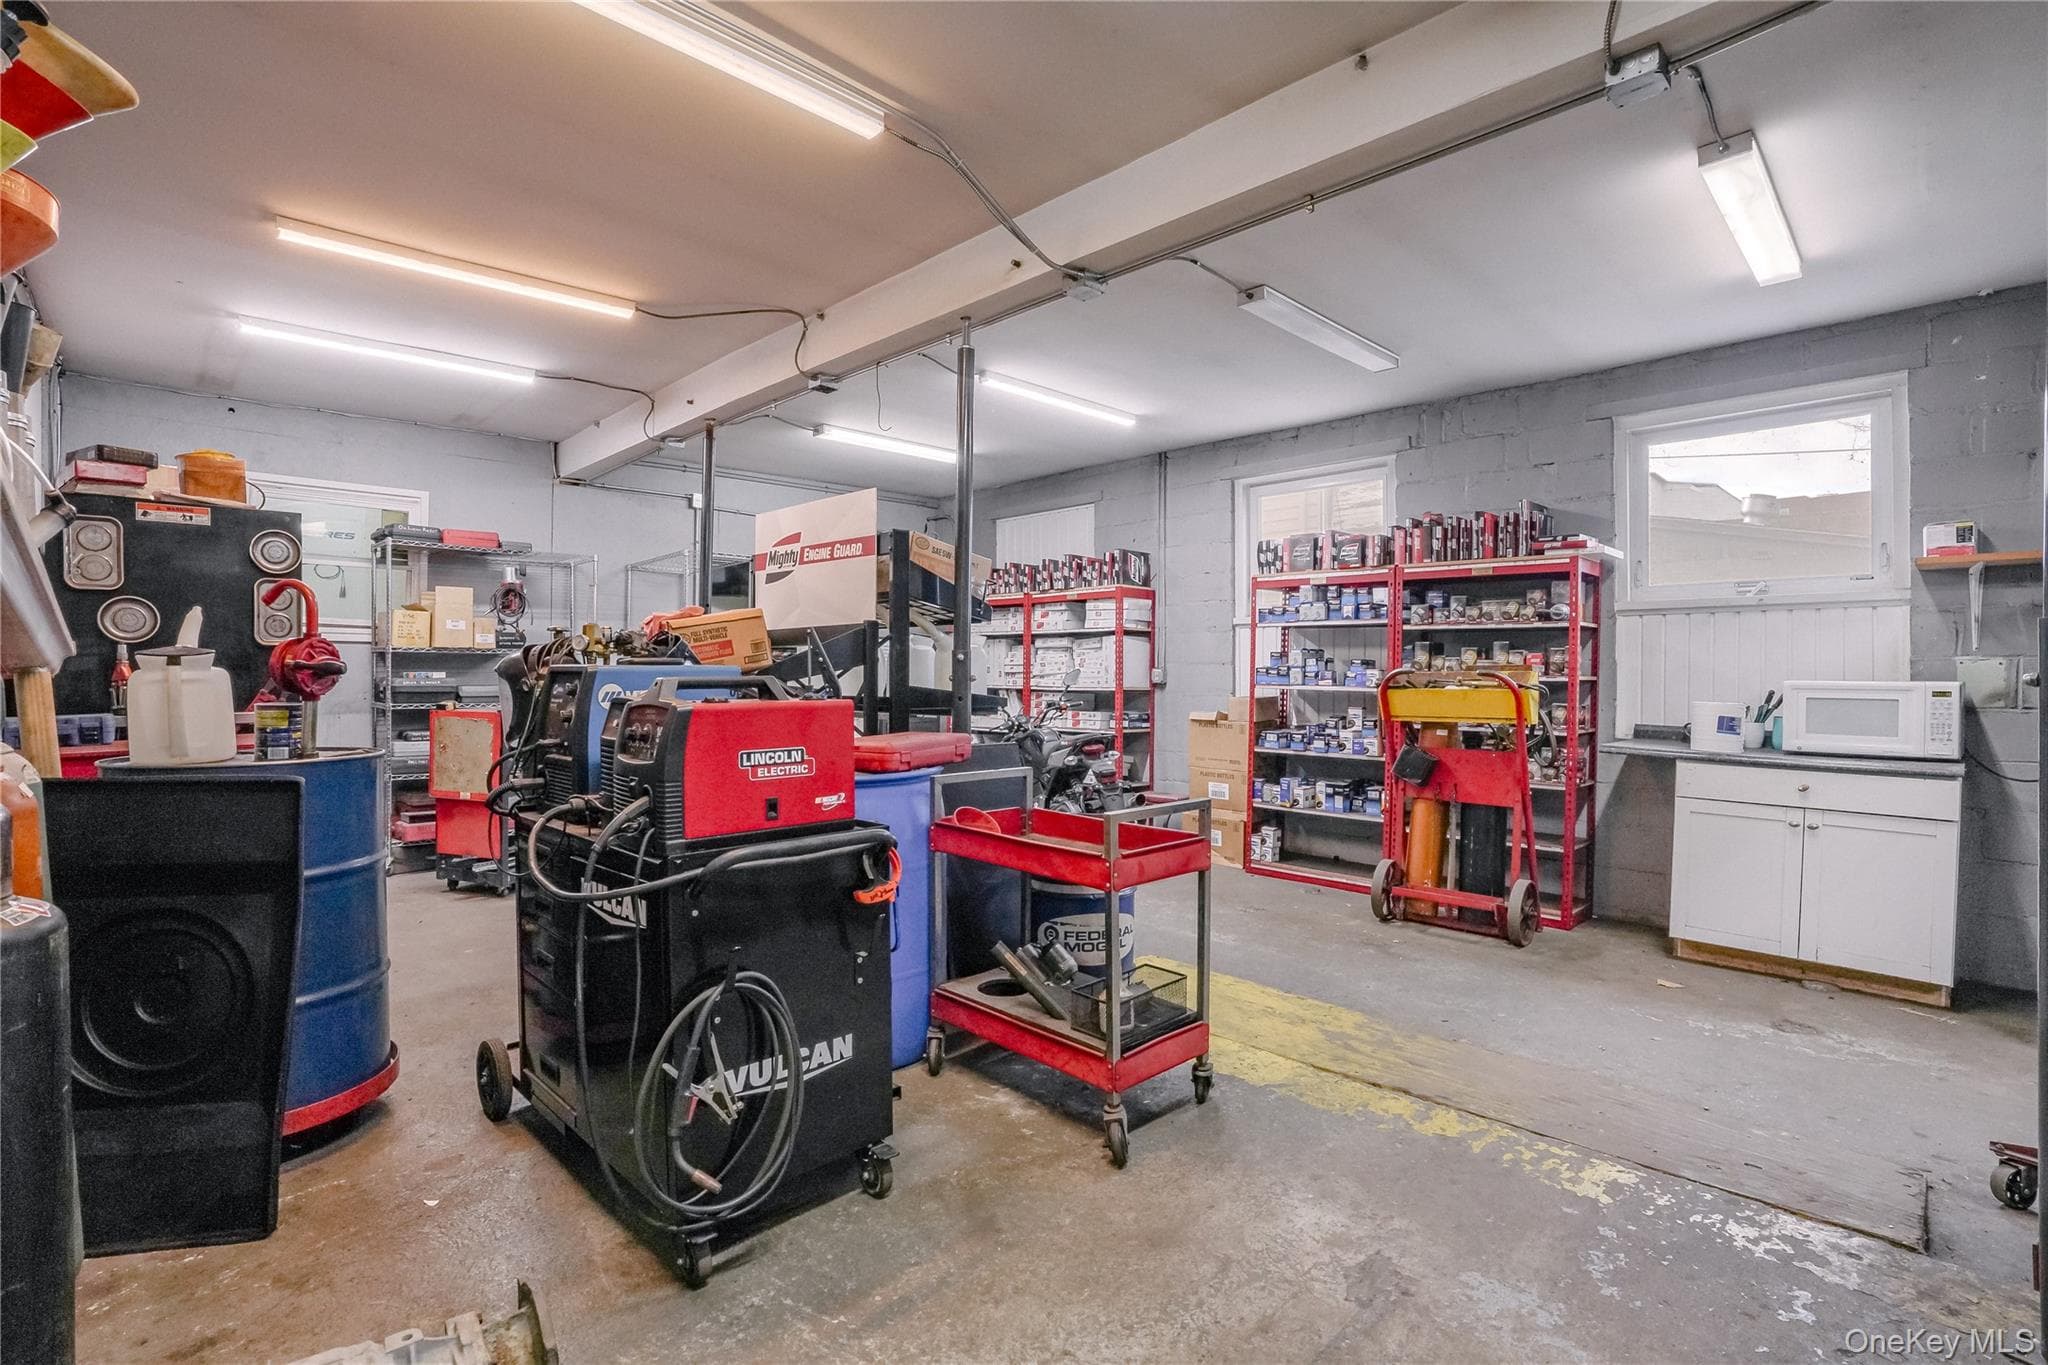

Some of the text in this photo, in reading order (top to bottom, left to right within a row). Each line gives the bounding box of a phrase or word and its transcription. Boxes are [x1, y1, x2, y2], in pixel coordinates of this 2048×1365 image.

[767, 543, 863, 569] Mighty ENGINE GUARD
[702, 626, 728, 635] SYNTHETIC
[742, 750, 803, 766] LINCOLN
[757, 764, 809, 777] ELECTRIC
[1064, 924, 1133, 941] FEDAL
[1064, 938, 1126, 952] MOGL
